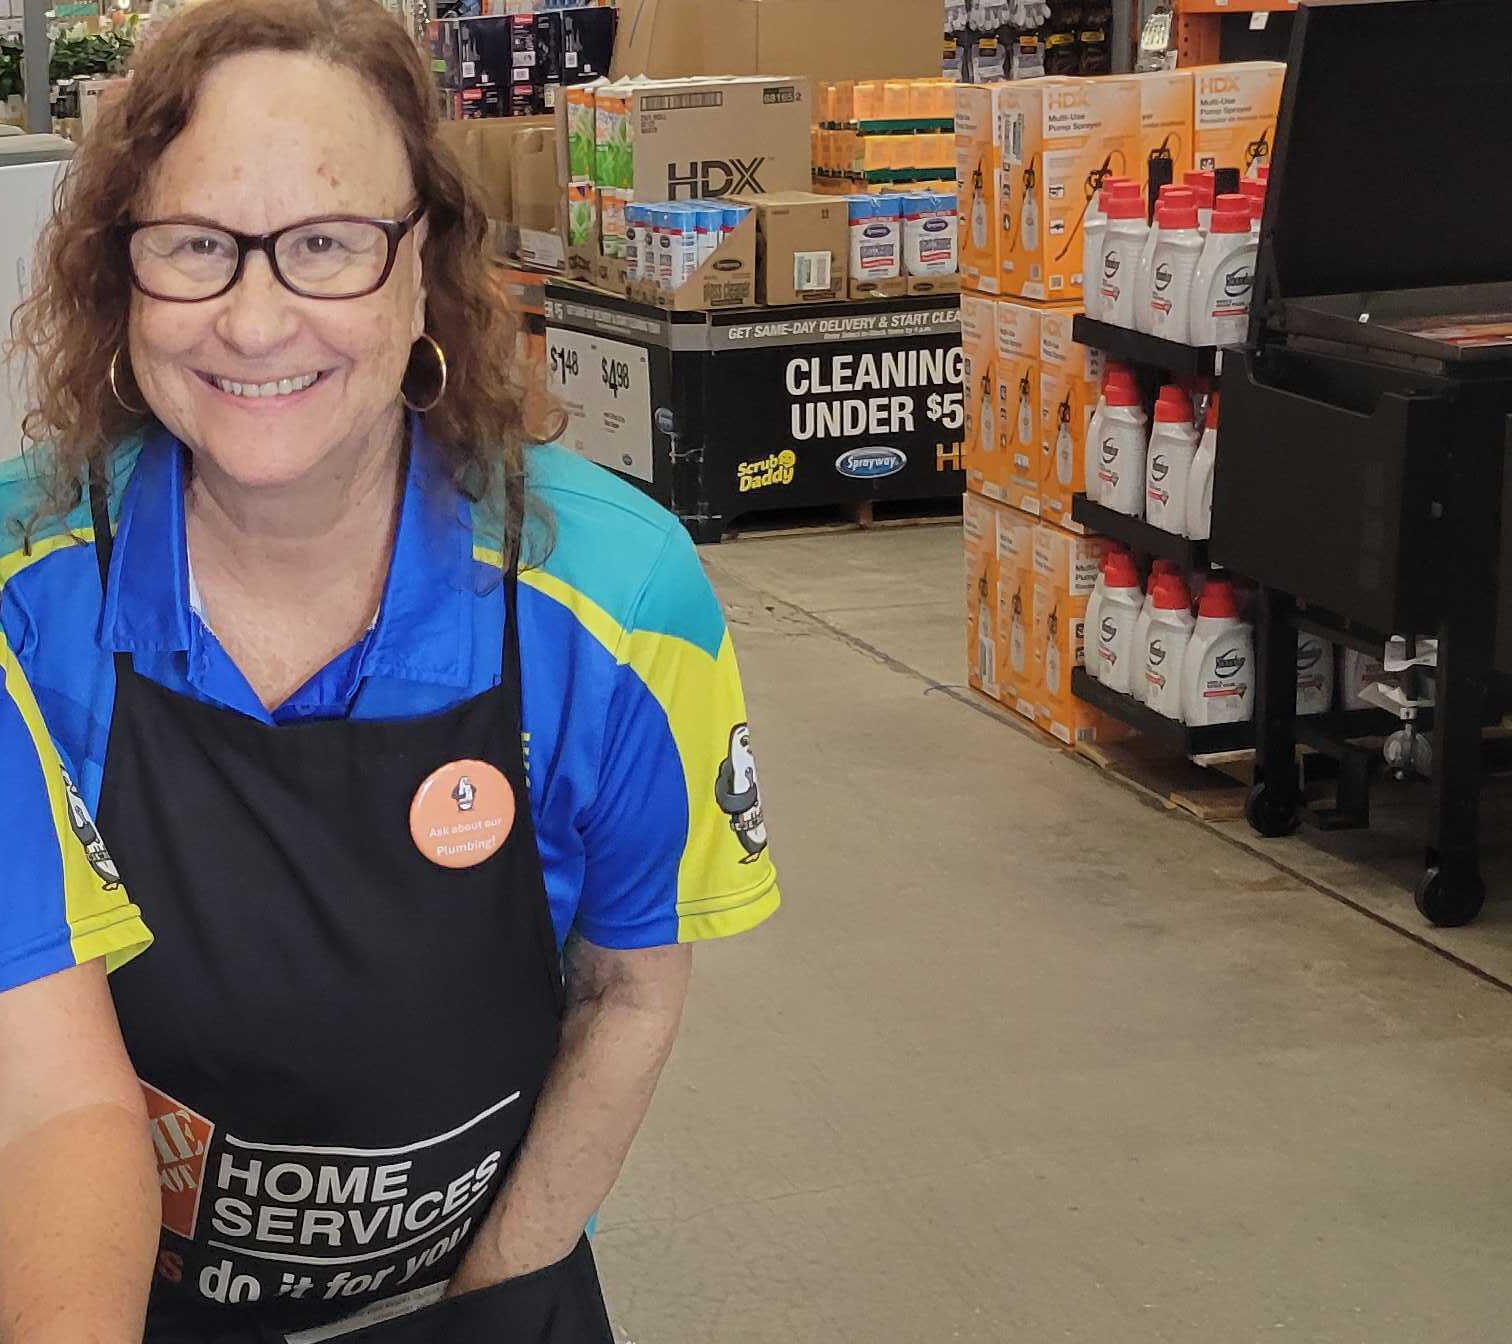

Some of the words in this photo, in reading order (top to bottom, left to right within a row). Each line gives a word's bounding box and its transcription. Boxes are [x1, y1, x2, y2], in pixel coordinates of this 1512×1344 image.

[1199, 77, 1239, 95] HDX
[1199, 97, 1237, 108] Multi-Use
[1048, 112, 1086, 124] Multi-Use
[668, 157, 766, 201] HDX
[728, 327, 752, 340] GET
[754, 321, 817, 339] SAME-DAY
[819, 316, 876, 333] DELIVERY
[879, 316, 888, 328] &
[891, 311, 930, 327] START
[931, 309, 961, 323] CLEA
[551, 344, 579, 384] $148
[601, 357, 629, 398] $498
[786, 346, 964, 396] CLEANING
[791, 396, 914, 440] UNDER
[926, 392, 964, 429] $5
[738, 453, 781, 478] Scrub
[846, 453, 897, 471] Sprayway
[739, 466, 795, 492] Daddy
[429, 824, 450, 839] Ask
[451, 820, 480, 837] about
[484, 817, 502, 830] our
[436, 834, 496, 858] Plumbing!
[217, 1152, 413, 1205] HOME
[212, 1150, 501, 1248] SERVICES
[199, 1259, 261, 1303] do
[323, 1265, 397, 1301] for
[403, 1217, 472, 1284] you
